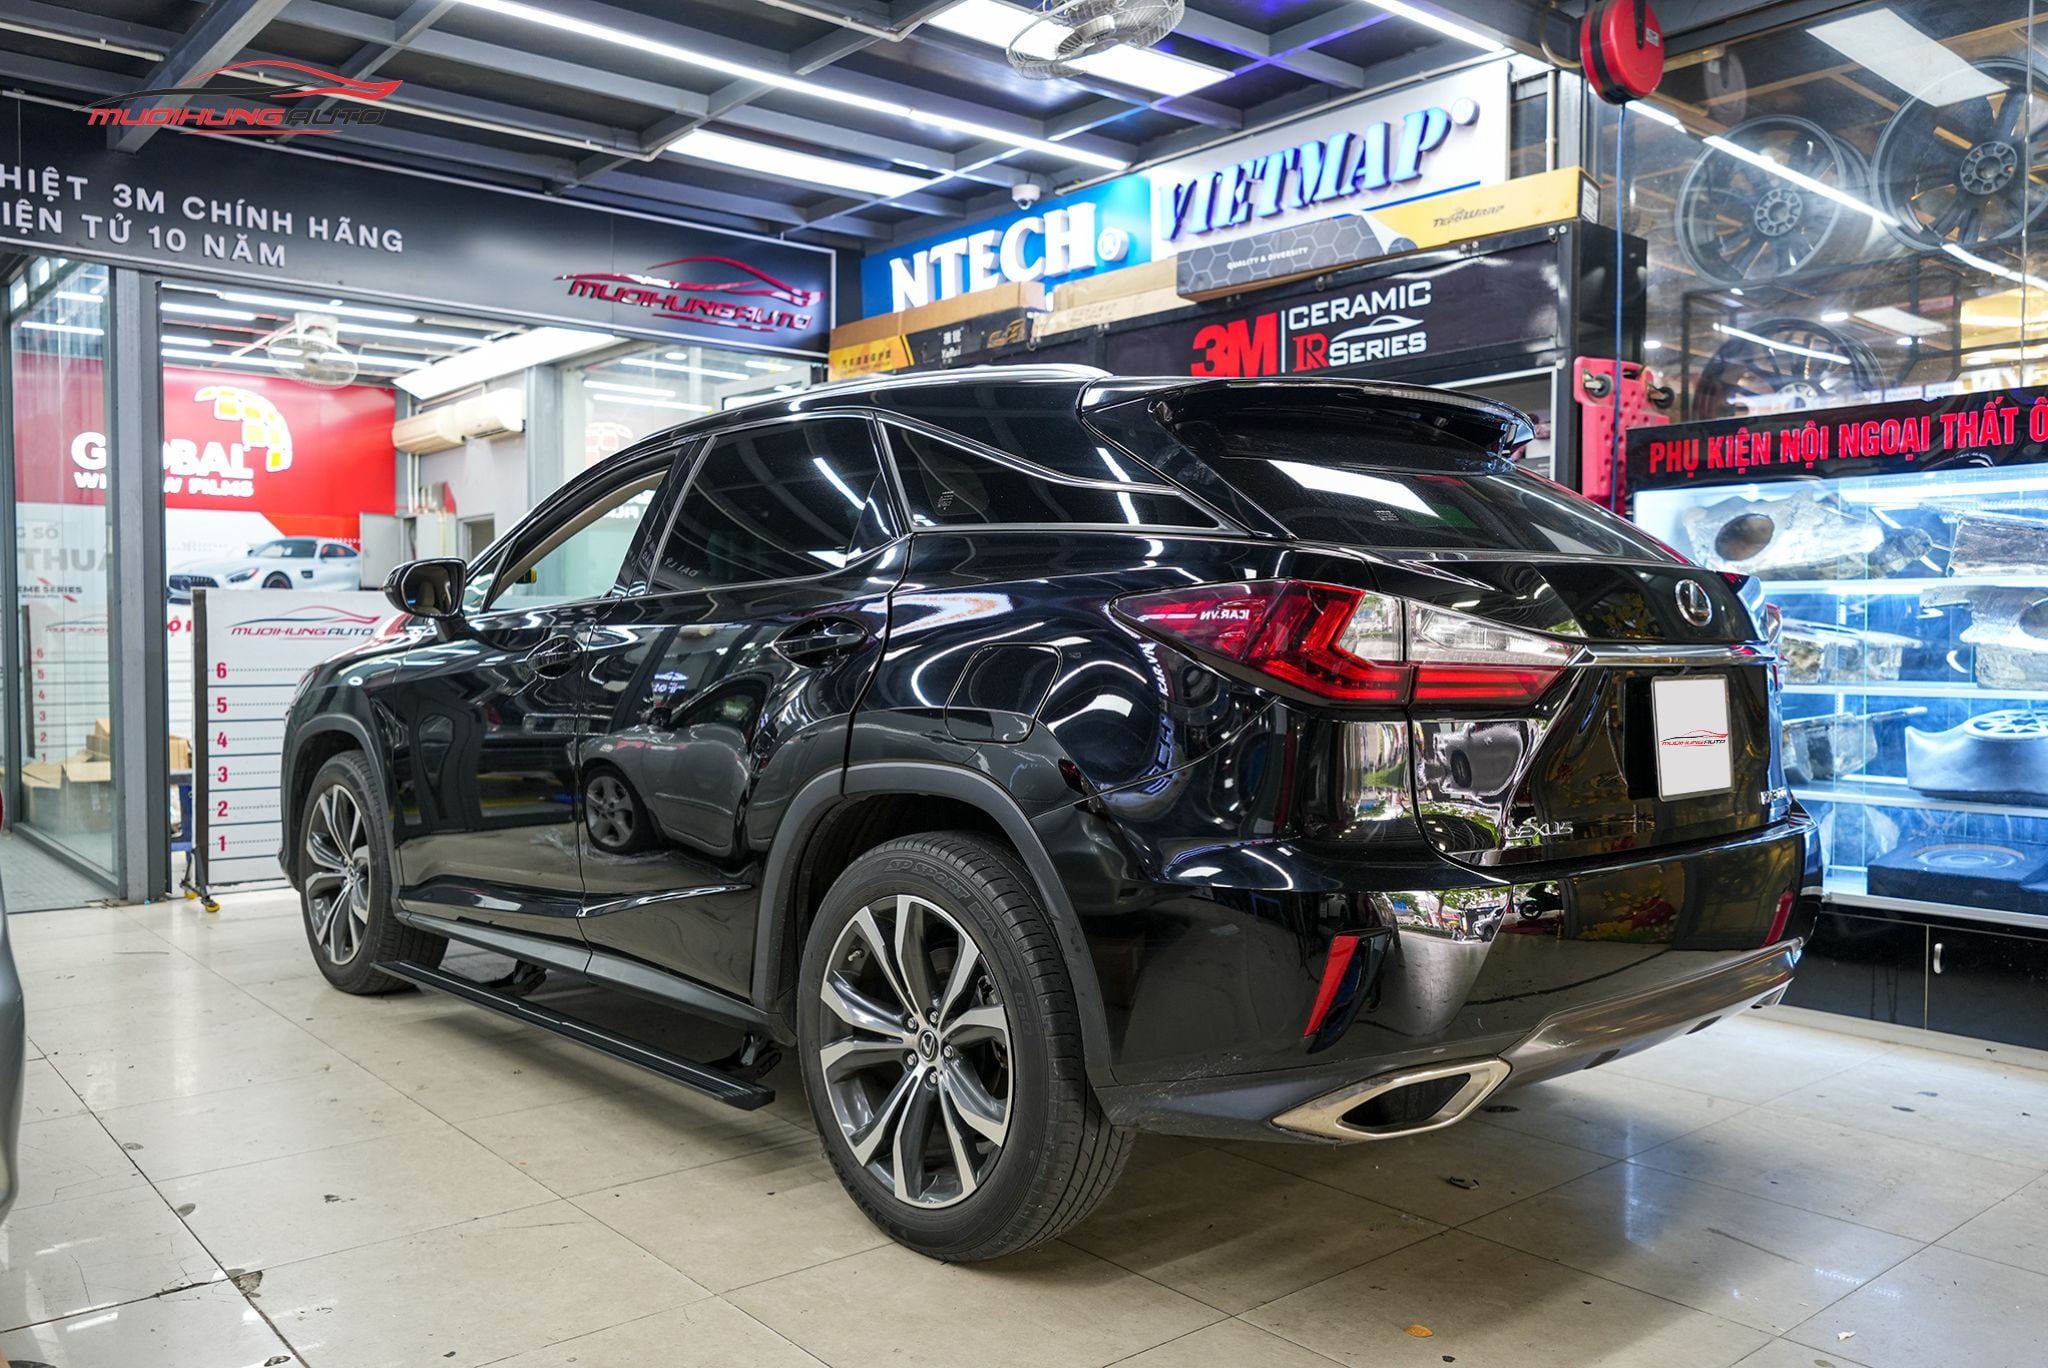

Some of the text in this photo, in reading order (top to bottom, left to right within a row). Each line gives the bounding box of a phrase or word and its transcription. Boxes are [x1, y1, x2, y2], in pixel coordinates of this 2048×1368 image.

[1160, 106, 1452, 241] VIETMAP
[112, 183, 165, 214] 3M
[182, 196, 293, 234] CHÍNH
[308, 216, 403, 252] HÃNG
[81, 213, 132, 244] TỬ
[148, 225, 187, 253] 10
[204, 233, 286, 267] NĂM
[1226, 256, 1260, 271] QUALITY
[1268, 246, 1309, 261] DIVERSITY
[1190, 280, 1432, 377] 3M CERAMIC
[1648, 438, 1700, 478] PHỤ
[1706, 426, 1771, 475] KIỆN
[1780, 420, 1829, 469] NỘI
[1839, 415, 1930, 461] NGOẠI
[1939, 397, 2019, 450] THẤT
[188, 478, 254, 497] FILMS
[216, 662, 228, 679] 6
[216, 697, 228, 713] 5
[216, 732, 228, 748] 4
[216, 766, 228, 783] 3
[216, 800, 228, 817] 2
[218, 835, 226, 851] 1
